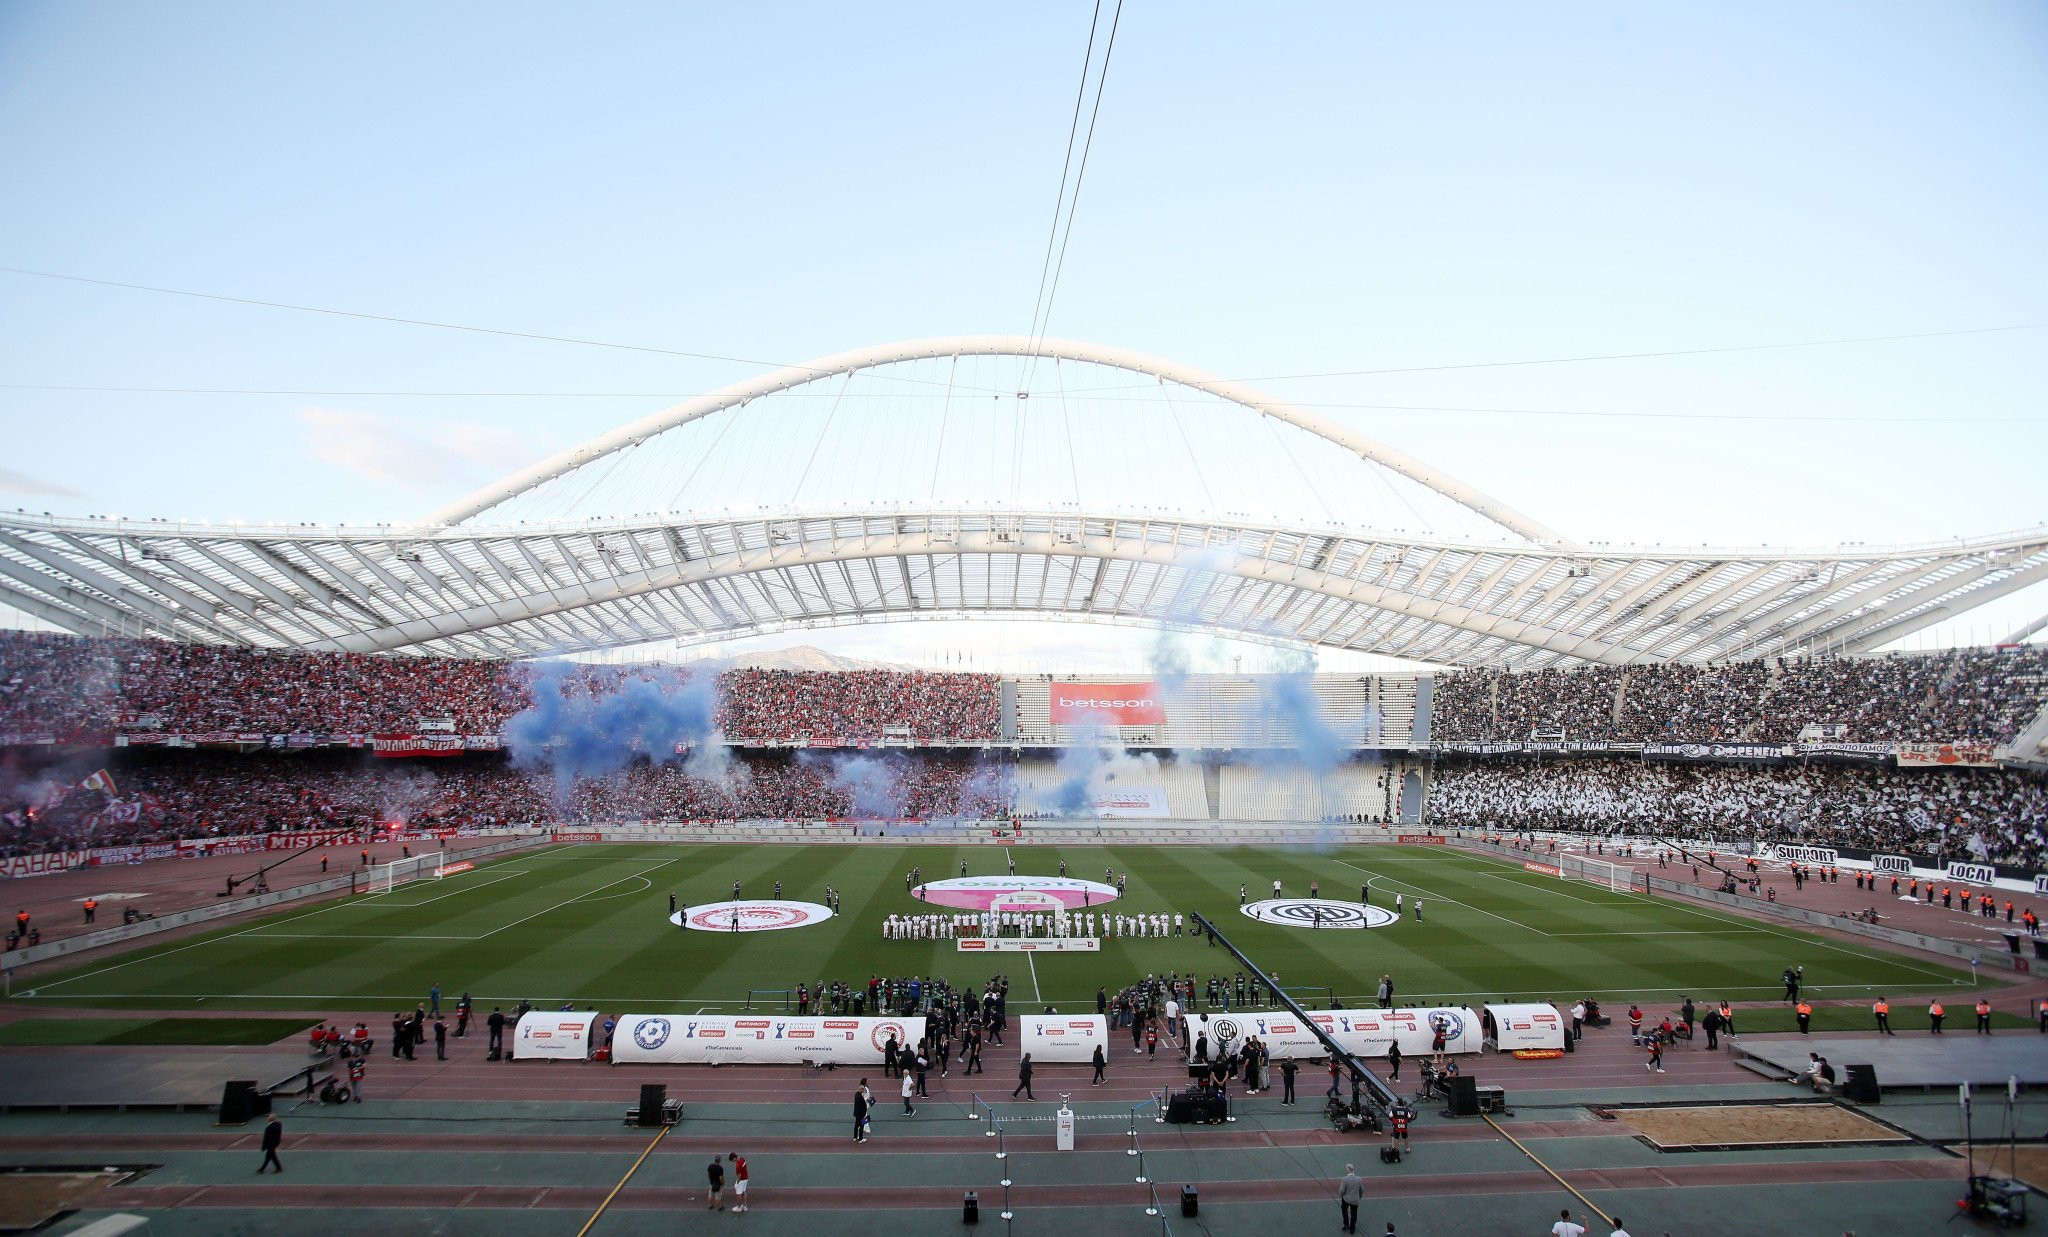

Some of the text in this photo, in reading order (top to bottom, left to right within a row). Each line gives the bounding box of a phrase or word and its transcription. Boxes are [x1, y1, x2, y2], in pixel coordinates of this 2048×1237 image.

[1583, 743, 1608, 751] ΕΛΛΑΔΑ
[1778, 846, 1835, 863] SUPPORT
[1873, 855, 1910, 872] YOUR
[1949, 864, 1993, 882] LOCAL
